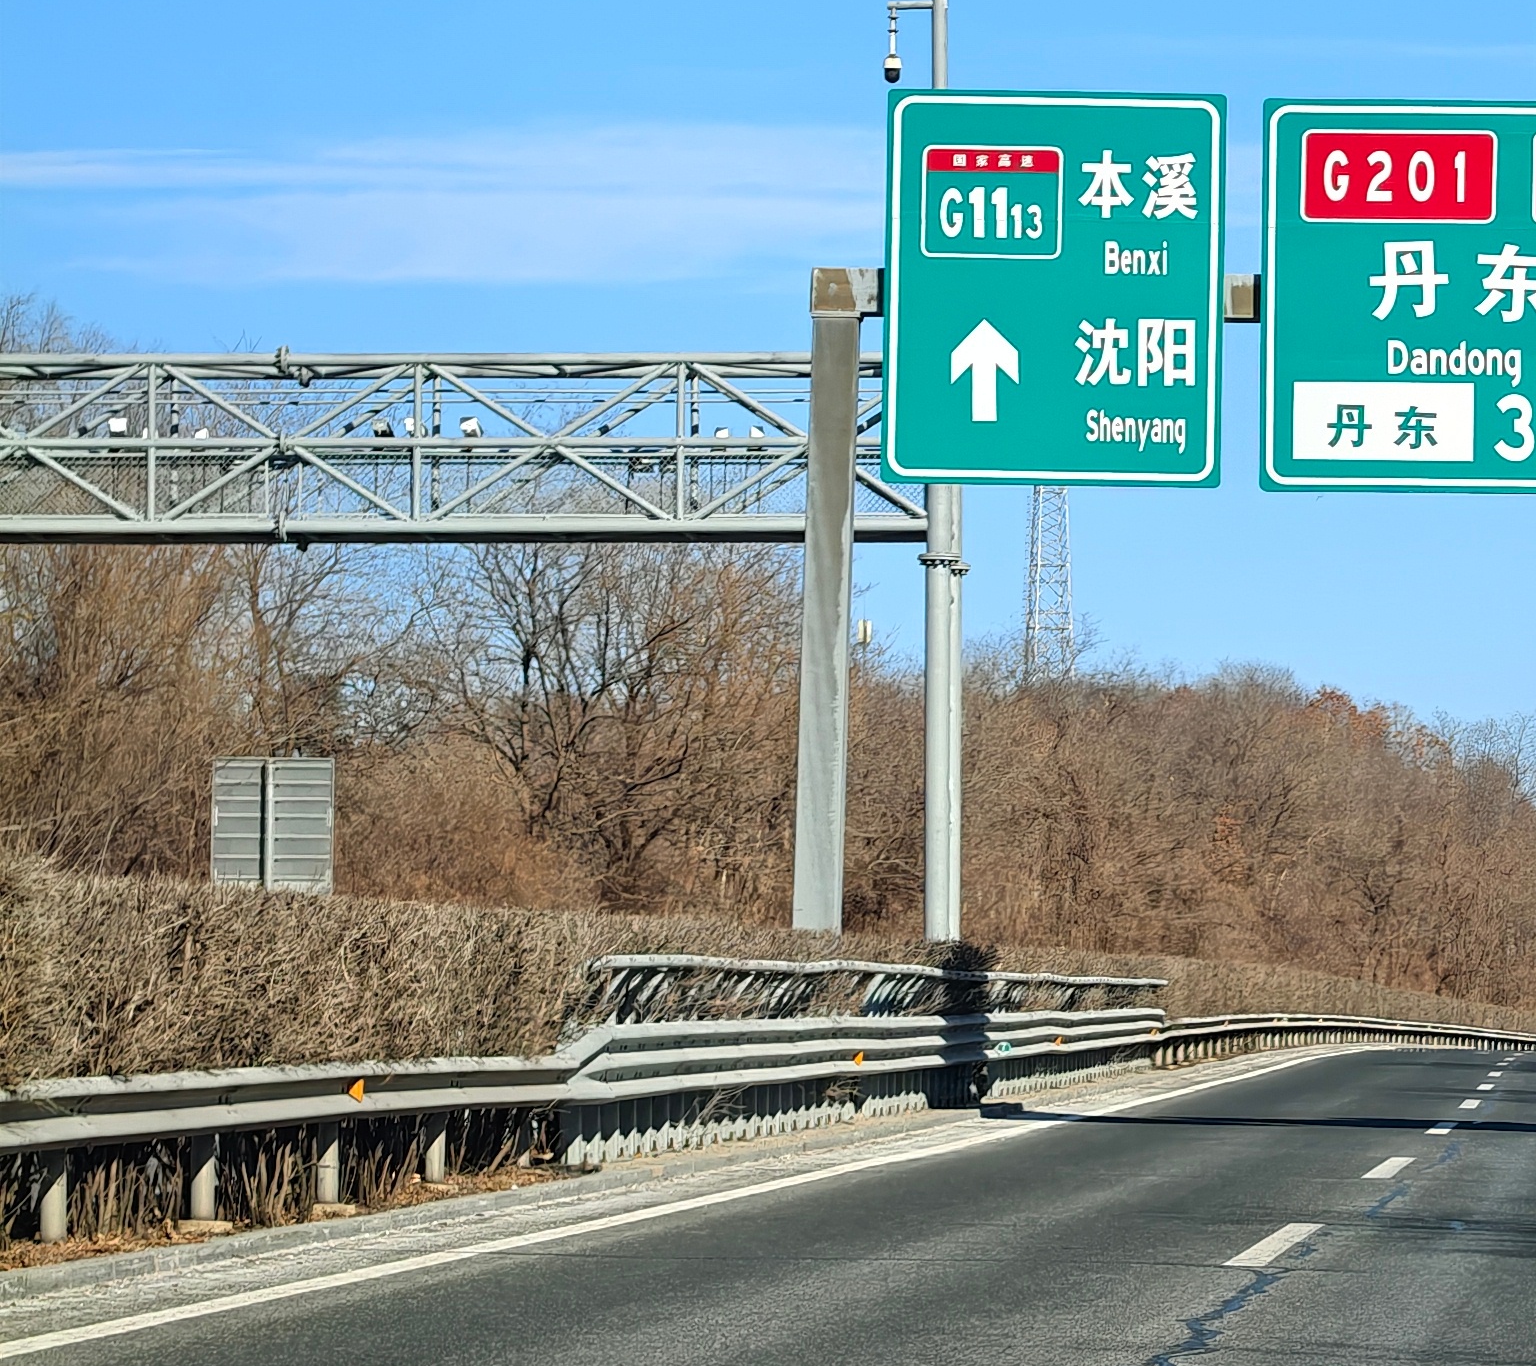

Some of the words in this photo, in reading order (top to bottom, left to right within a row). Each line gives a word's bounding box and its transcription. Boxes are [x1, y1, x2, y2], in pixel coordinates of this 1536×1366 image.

[1079, 150, 1199, 220] 本溪
[1323, 149, 1467, 204] G201
[1104, 240, 1168, 276] Benxi
[1074, 318, 1196, 387] 沈阳
[1387, 339, 1522, 387] Dandong
[1085, 409, 1186, 454] Shenyang
[1327, 403, 1438, 450] 丹东
